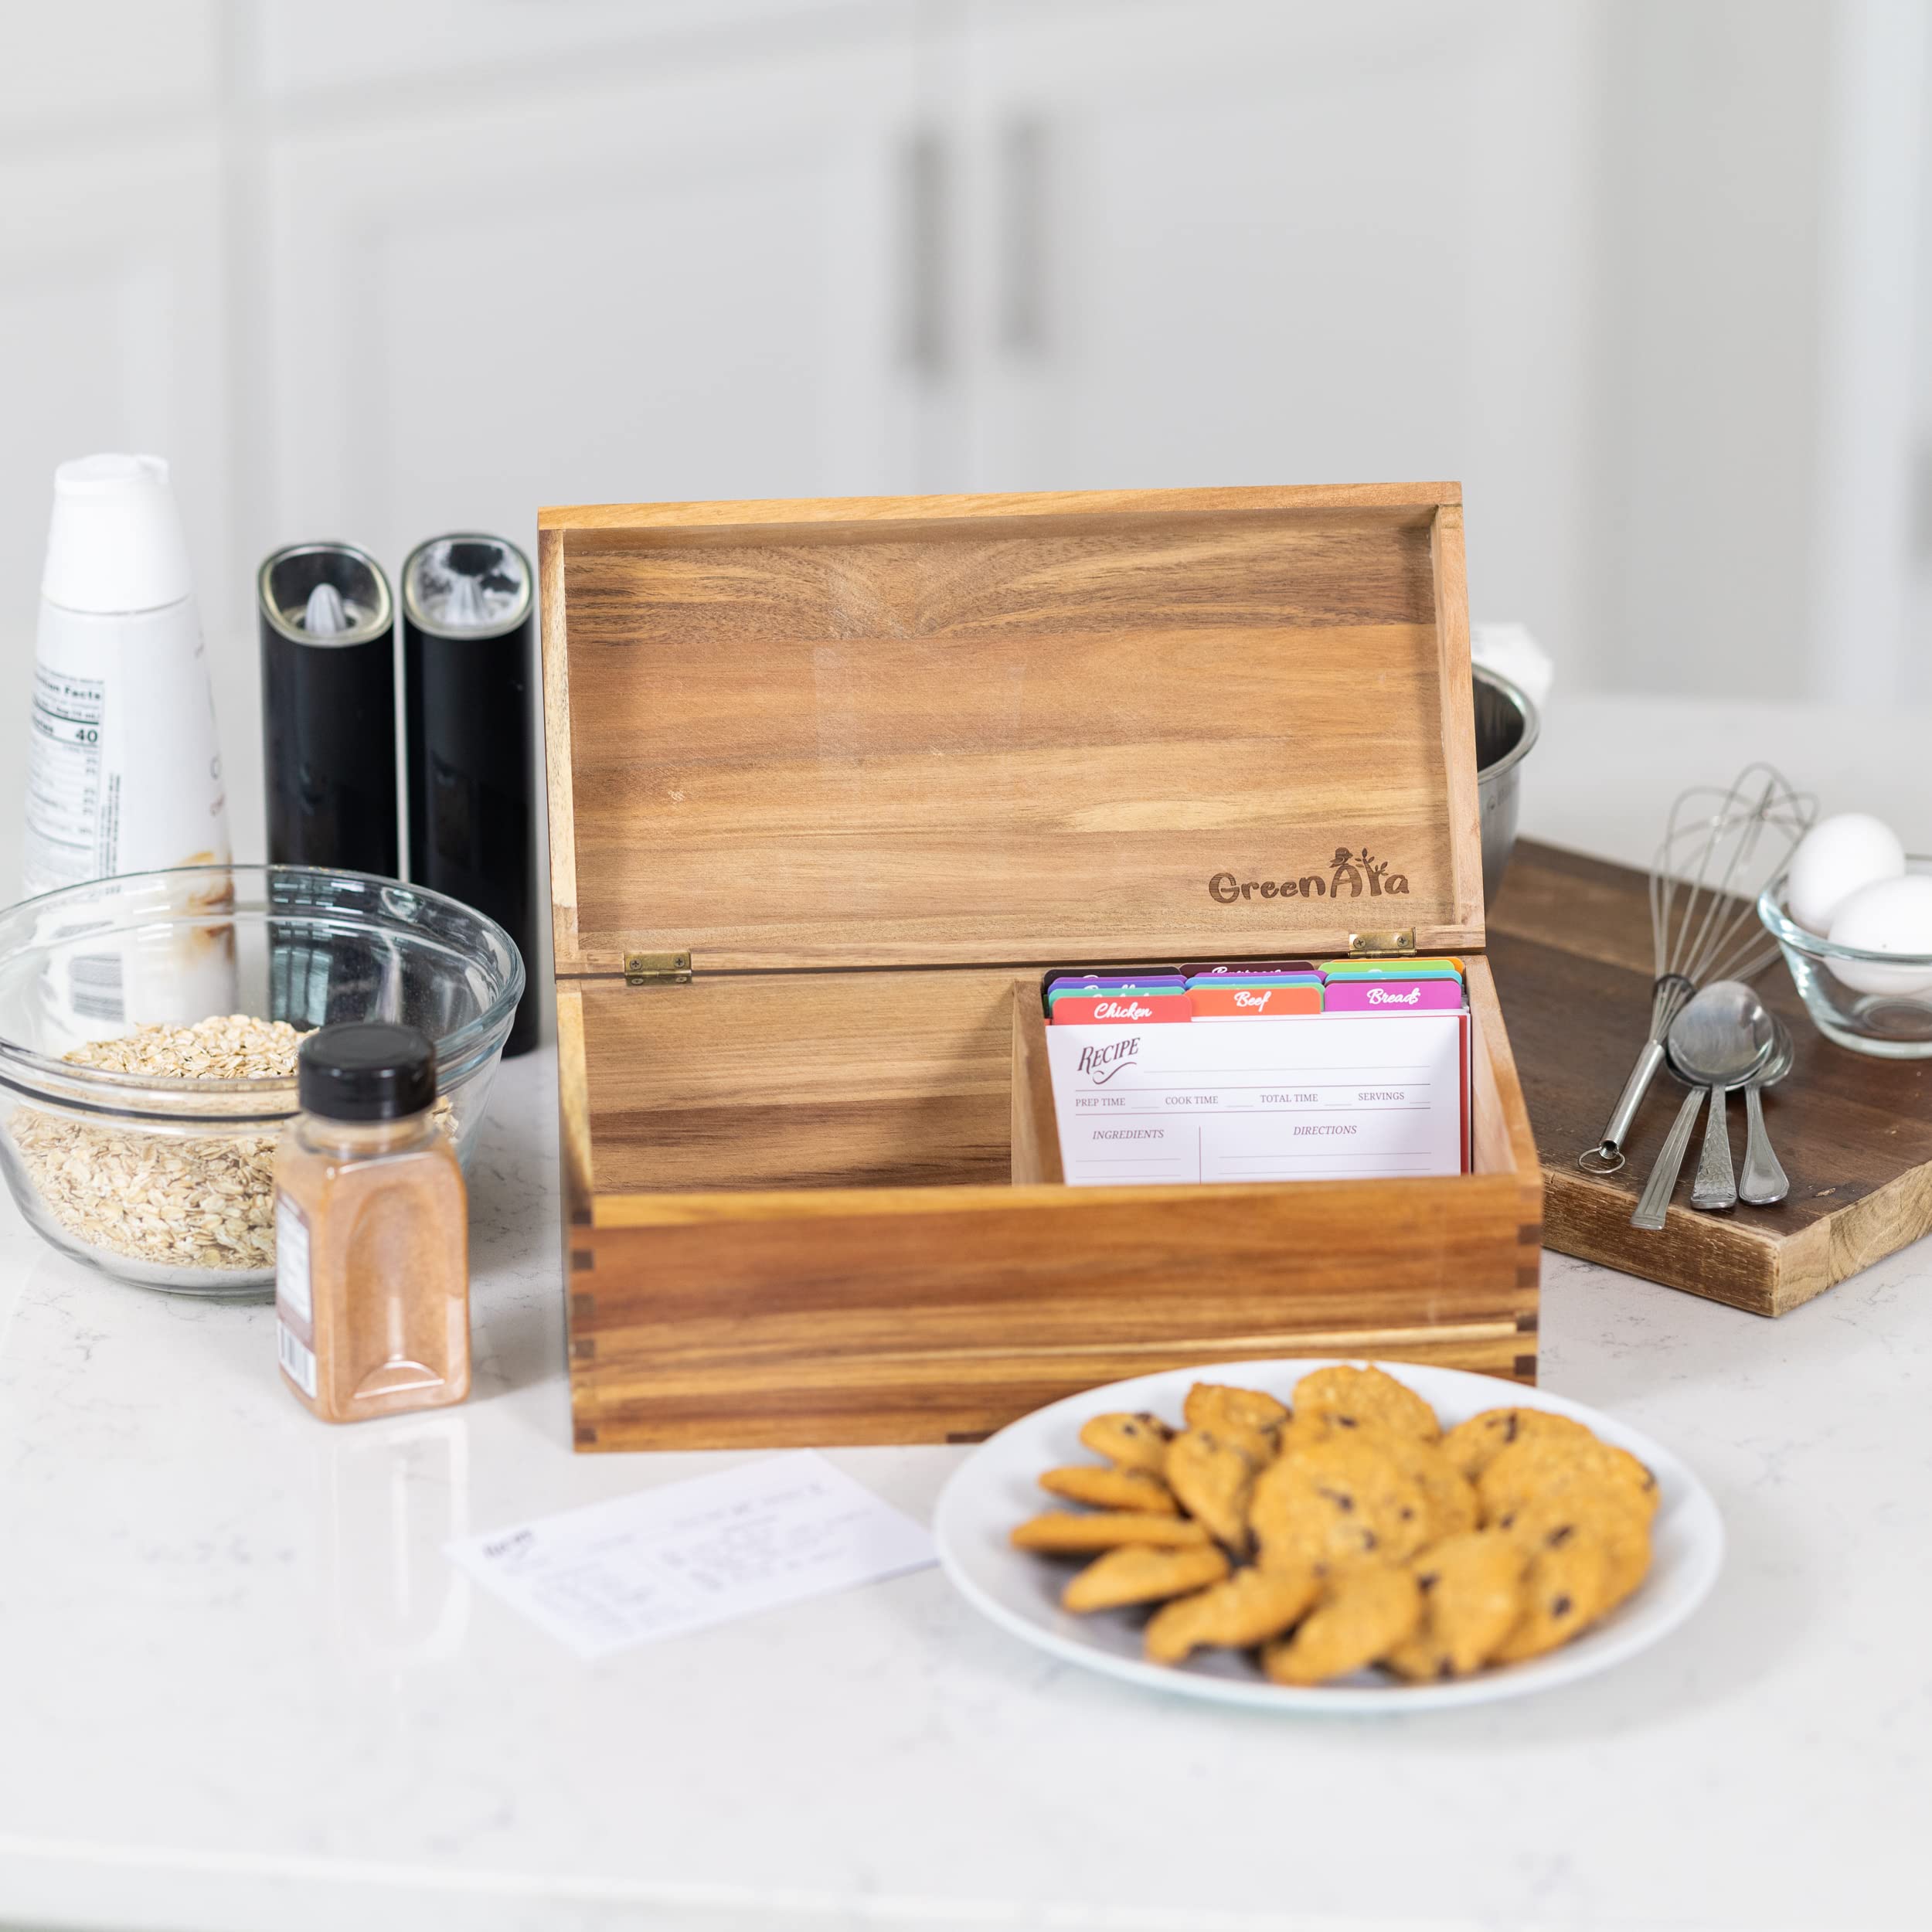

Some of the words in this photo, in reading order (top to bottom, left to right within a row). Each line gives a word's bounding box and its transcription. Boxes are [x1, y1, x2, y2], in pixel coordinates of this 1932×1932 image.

[76, 729, 98, 743] 40
[1233, 990, 1272, 1012] Beef
[1366, 988, 1421, 1005] Breads
[1094, 1002, 1153, 1021] Chicken
[1077, 1037, 1141, 1075] RECIPE
[1165, 1096, 1193, 1105] COOK
[1193, 1095, 1219, 1105] TIME
[1260, 1094, 1292, 1104] TOTAL
[1293, 1094, 1319, 1103] TIME
[1358, 1091, 1405, 1101] SERVINGS
[1075, 1098, 1100, 1107] PREP
[1101, 1097, 1126, 1107] TIME
[1092, 1129, 1165, 1140] INGREDIENTS
[1292, 1124, 1358, 1135] DIRECTIONS
